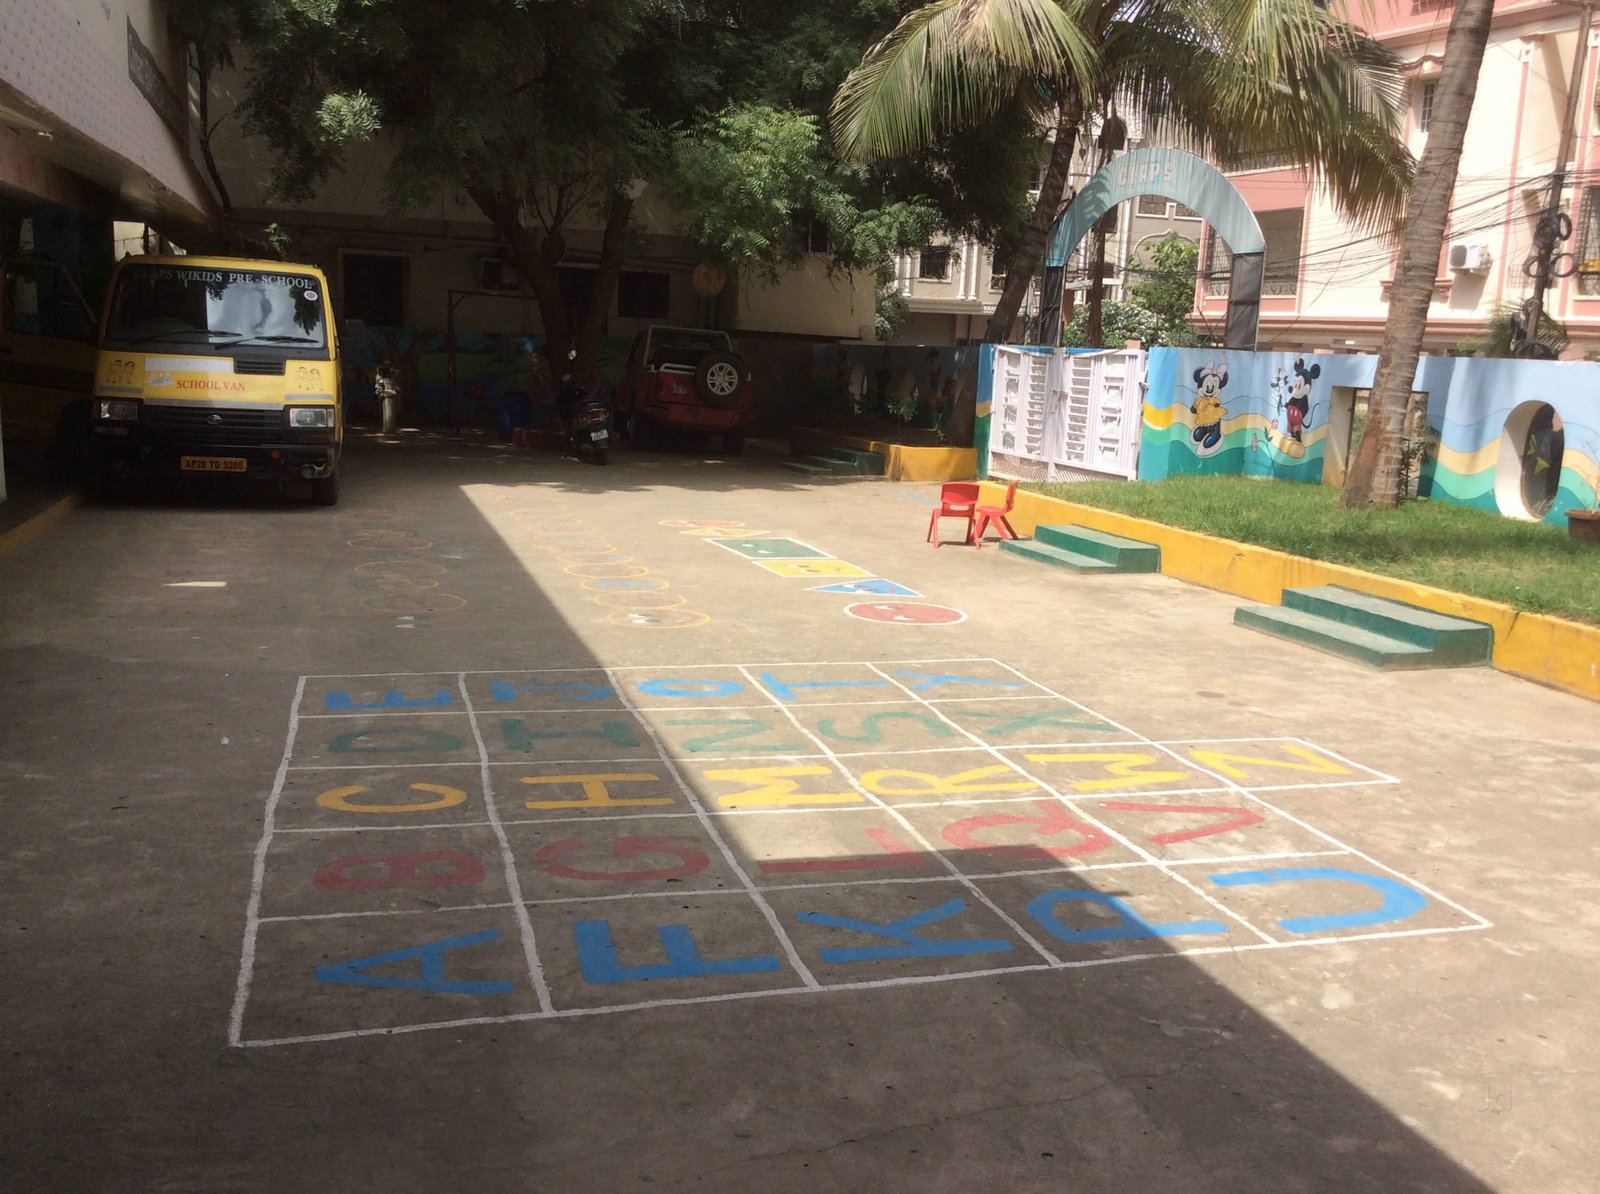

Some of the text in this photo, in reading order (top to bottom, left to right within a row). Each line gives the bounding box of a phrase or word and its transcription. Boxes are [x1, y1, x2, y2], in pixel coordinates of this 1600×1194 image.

[177, 270, 223, 282] WIKIDS
[176, 379, 220, 390] SCHOOL
[223, 382, 246, 391] VAN
[636, 679, 745, 697] O
[896, 670, 1023, 691] Y
[503, 719, 640, 750] I
[954, 704, 1120, 735] X
[1189, 744, 1353, 779] Z
[520, 773, 677, 809] H
[704, 766, 865, 806] M
[759, 673, 1228, 943] P Q R S T
[1098, 802, 1265, 845] V
[313, 691, 515, 995] A B C D E
[534, 837, 710, 881] G
[759, 827, 930, 873] L
[1209, 867, 1427, 934] U
[796, 898, 1015, 964] K
[572, 919, 781, 985] F
